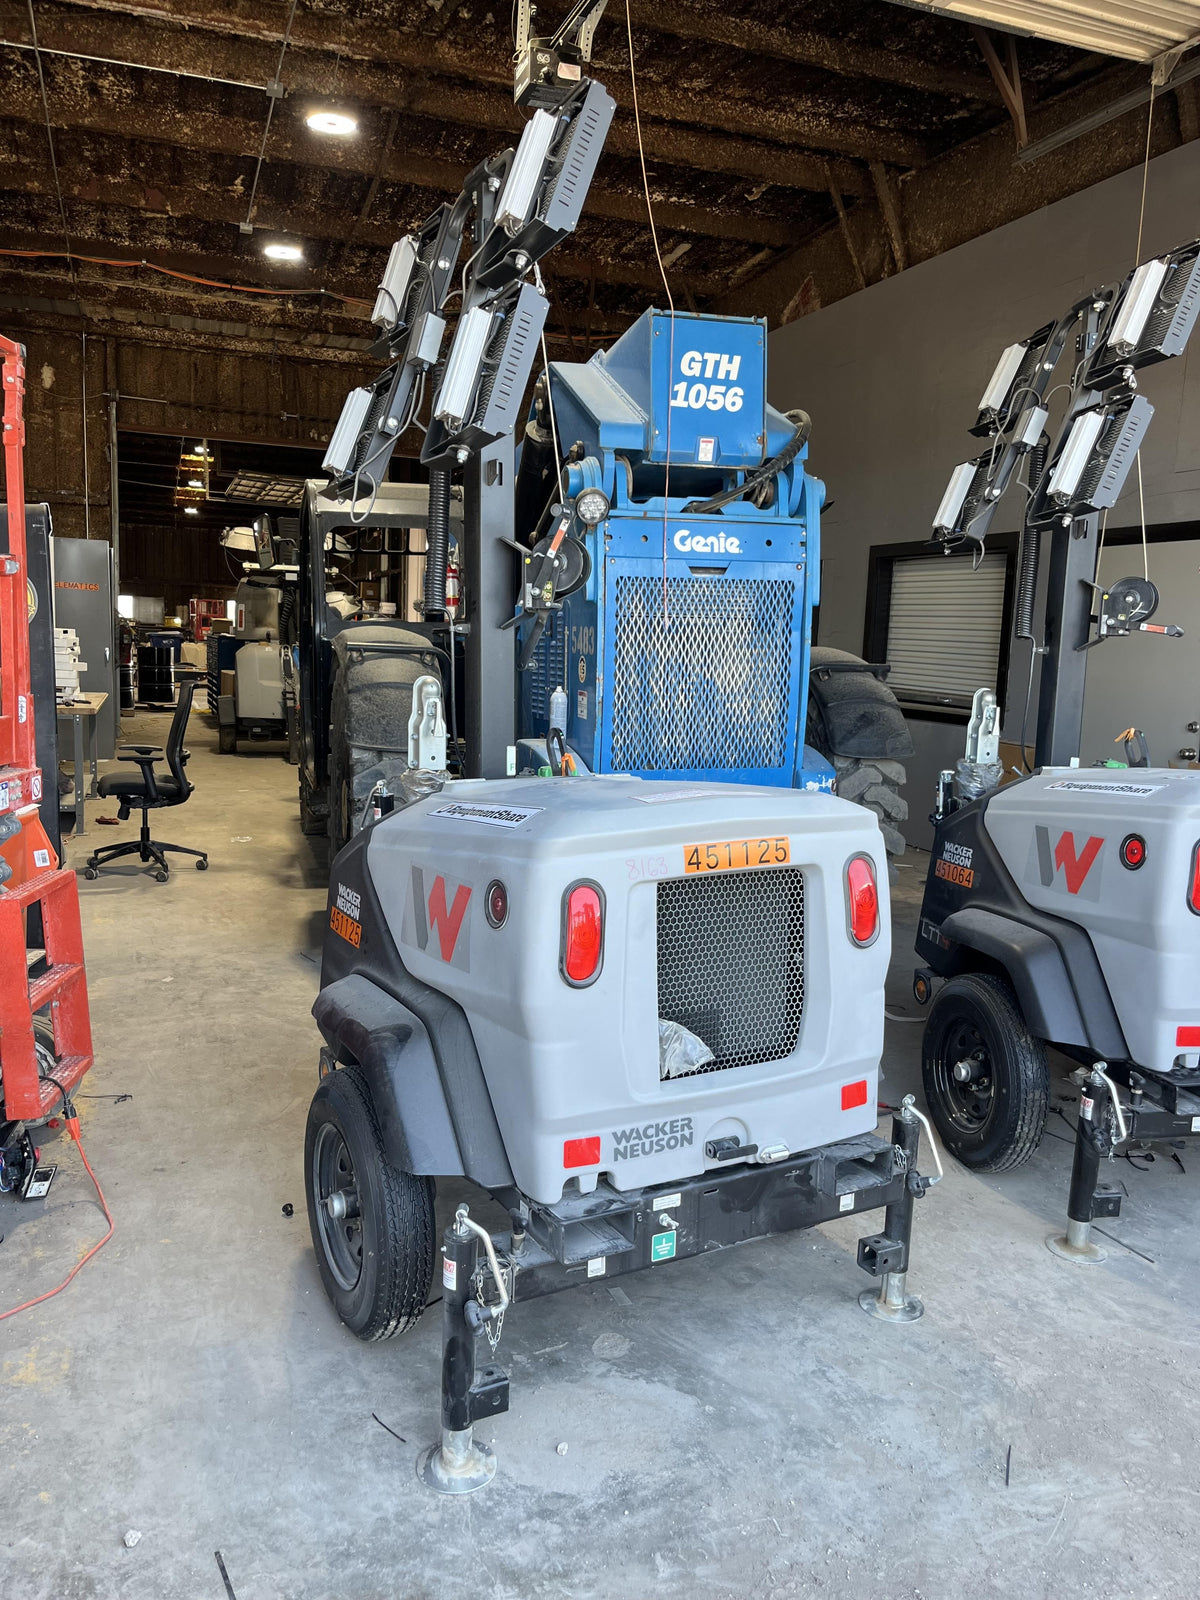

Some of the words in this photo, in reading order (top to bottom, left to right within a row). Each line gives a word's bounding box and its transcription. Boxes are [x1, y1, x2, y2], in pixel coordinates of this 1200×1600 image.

[680, 350, 742, 381] GTH
[669, 381, 744, 412] 1056
[673, 529, 741, 554] Genie
[572, 625, 595, 655] 5483
[687, 838, 788, 871] 451125
[942, 852, 972, 869] NEUSON
[944, 841, 973, 858] WACKER
[625, 856, 669, 881] 8163
[936, 863, 973, 886] 451064
[336, 895, 360, 921] NEUSON
[338, 882, 361, 908] WACKER
[330, 908, 361, 946] 451125
[611, 1116, 694, 1146] WACKER
[613, 1131, 694, 1162] NEUSON
